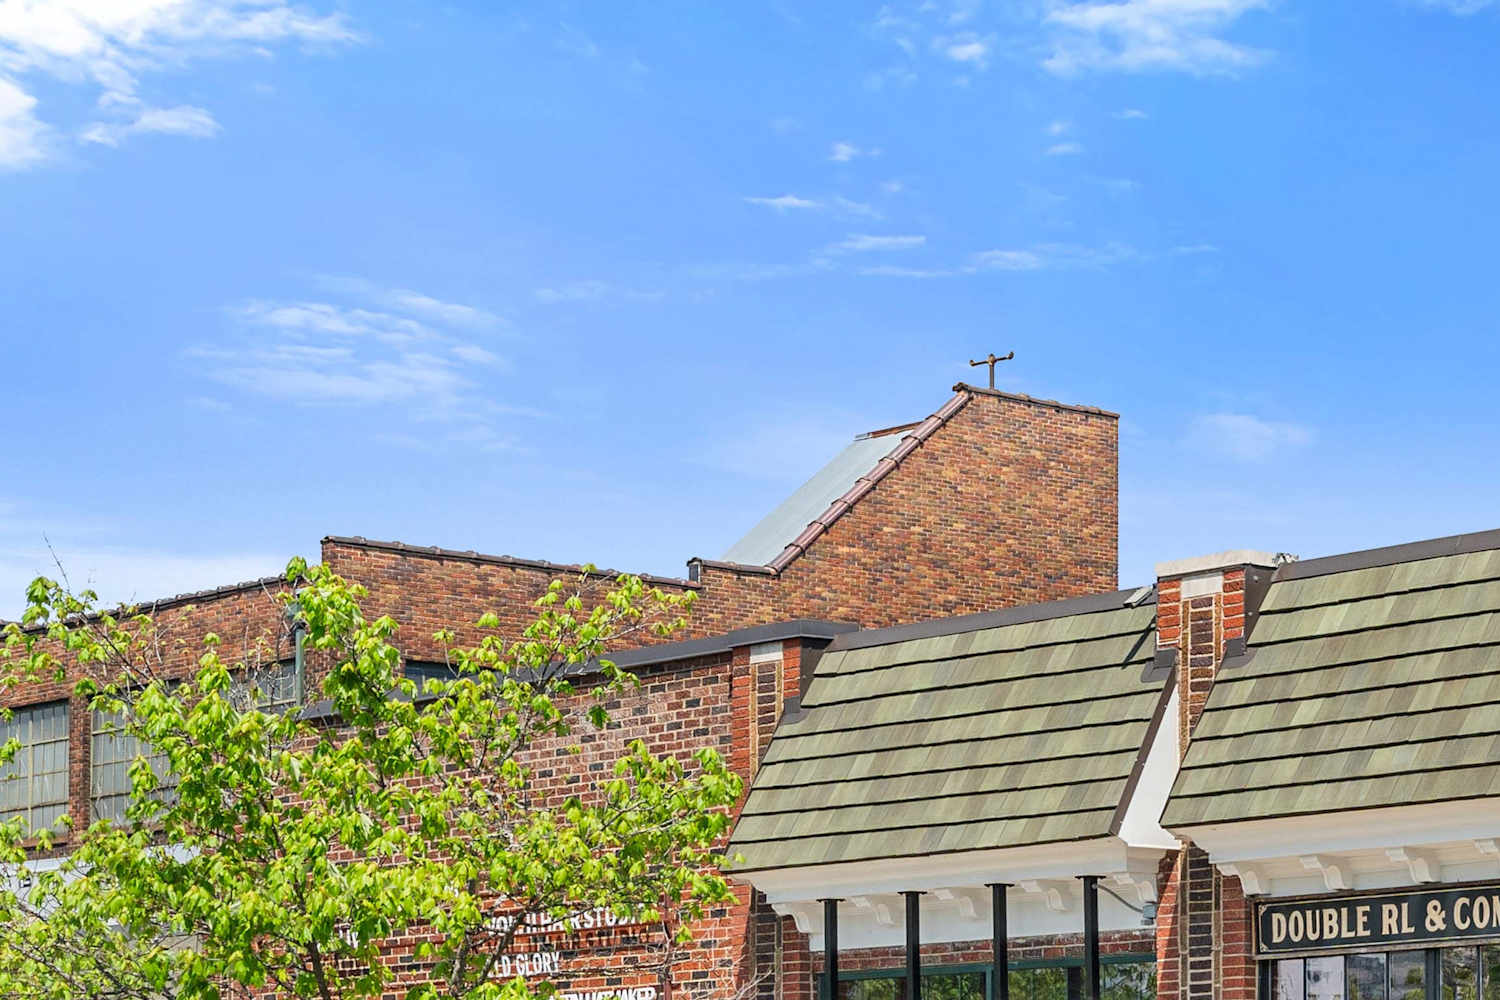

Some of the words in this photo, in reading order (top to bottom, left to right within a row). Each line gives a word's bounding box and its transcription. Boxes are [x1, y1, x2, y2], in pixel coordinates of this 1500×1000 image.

[1272, 904, 1371, 943] DOUBLE
[1381, 902, 1416, 935] RL
[1425, 900, 1447, 932] &
[516, 951, 560, 976] GLORY
